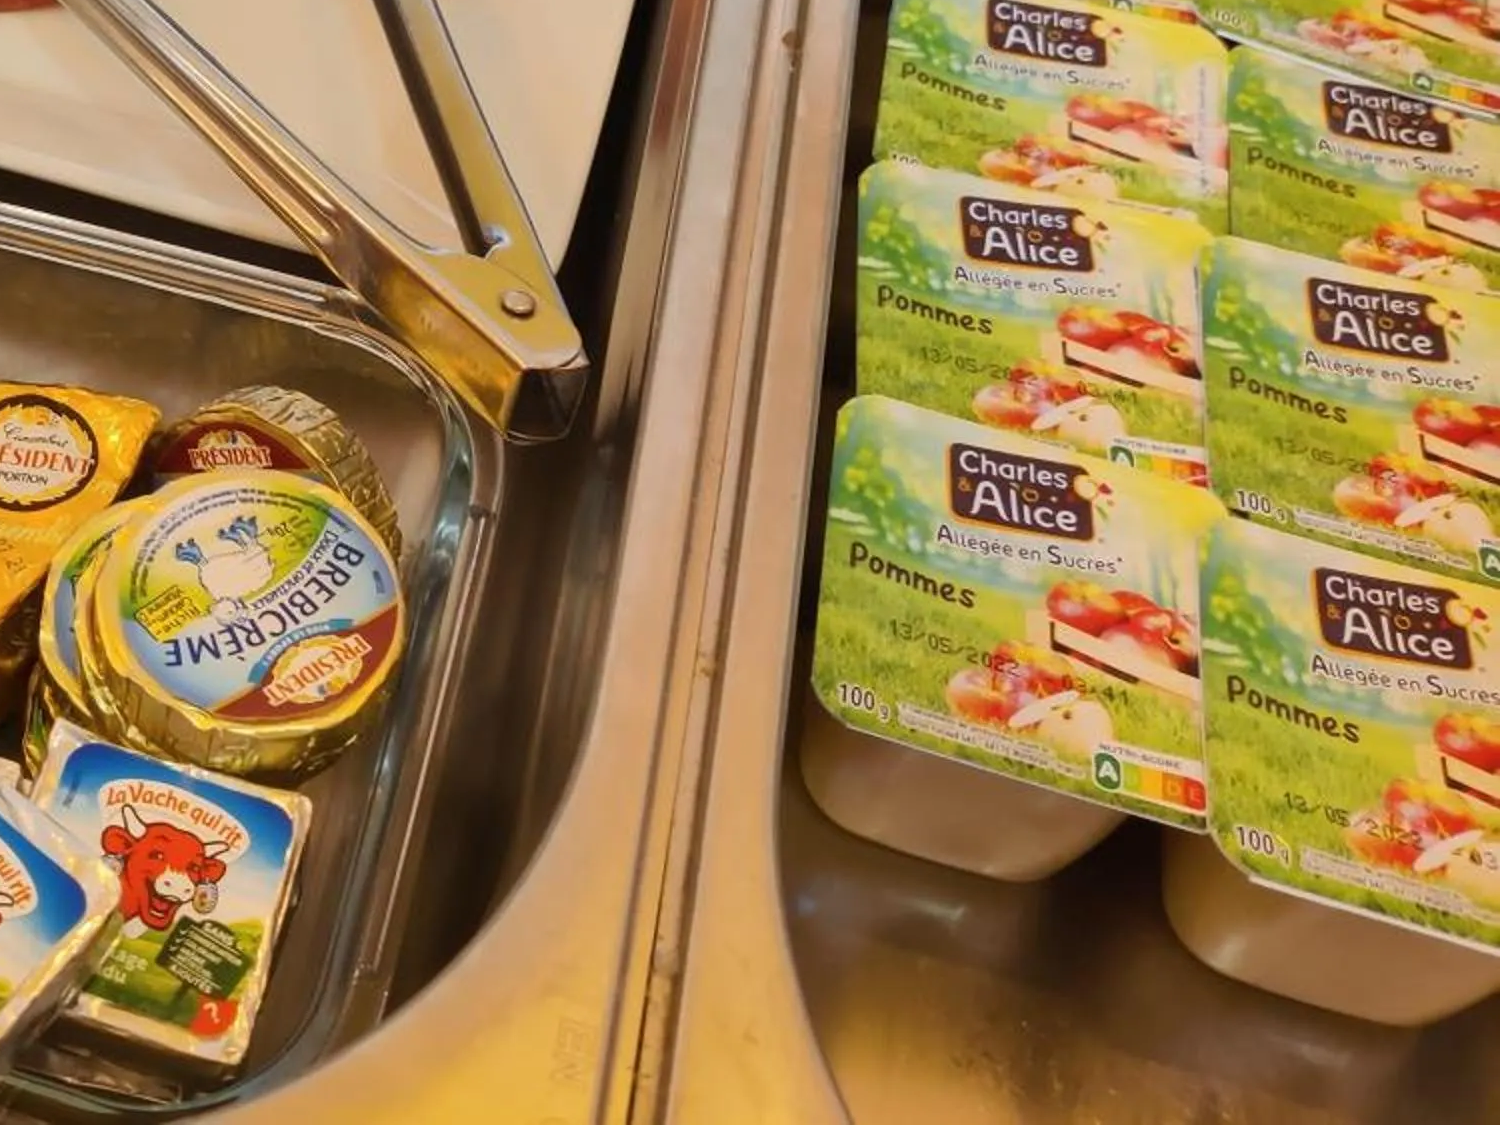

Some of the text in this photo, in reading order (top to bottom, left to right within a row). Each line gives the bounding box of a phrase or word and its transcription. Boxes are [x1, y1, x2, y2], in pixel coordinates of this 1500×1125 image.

[994, 3, 1087, 33] Charles
[1003, 25, 1097, 63] Alice
[900, 61, 1008, 112] Pommes
[1330, 86, 1428, 116] Charles
[1345, 108, 1438, 149] Alice
[1246, 145, 1358, 199] Pommes
[968, 201, 1068, 231] Charles
[981, 226, 1080, 267] Alice
[1027, 280, 1050, 293] en
[1316, 283, 1421, 317] Charles
[876, 283, 995, 337] Pommes
[1332, 310, 1436, 357] Alice
[1381, 366, 1404, 381] en
[1229, 364, 1349, 425] Pommes
[959, 449, 1068, 491] Charles
[971, 480, 1078, 532] Alice
[1235, 489, 1271, 516] 100
[849, 540, 977, 609] Pommes
[1018, 546, 1042, 562] en
[163, 541, 366, 668] BREBICRÈME
[1324, 574, 1441, 616] Charles
[1342, 609, 1457, 662] Alice
[838, 683, 876, 712] 100
[1397, 677, 1422, 693] en
[1225, 674, 1362, 746] Pommes
[1098, 760, 1119, 783] A
[106, 781, 244, 851] La Vache qui rit
[1235, 824, 1276, 857] 100
[6, 873, 33, 909] rit
